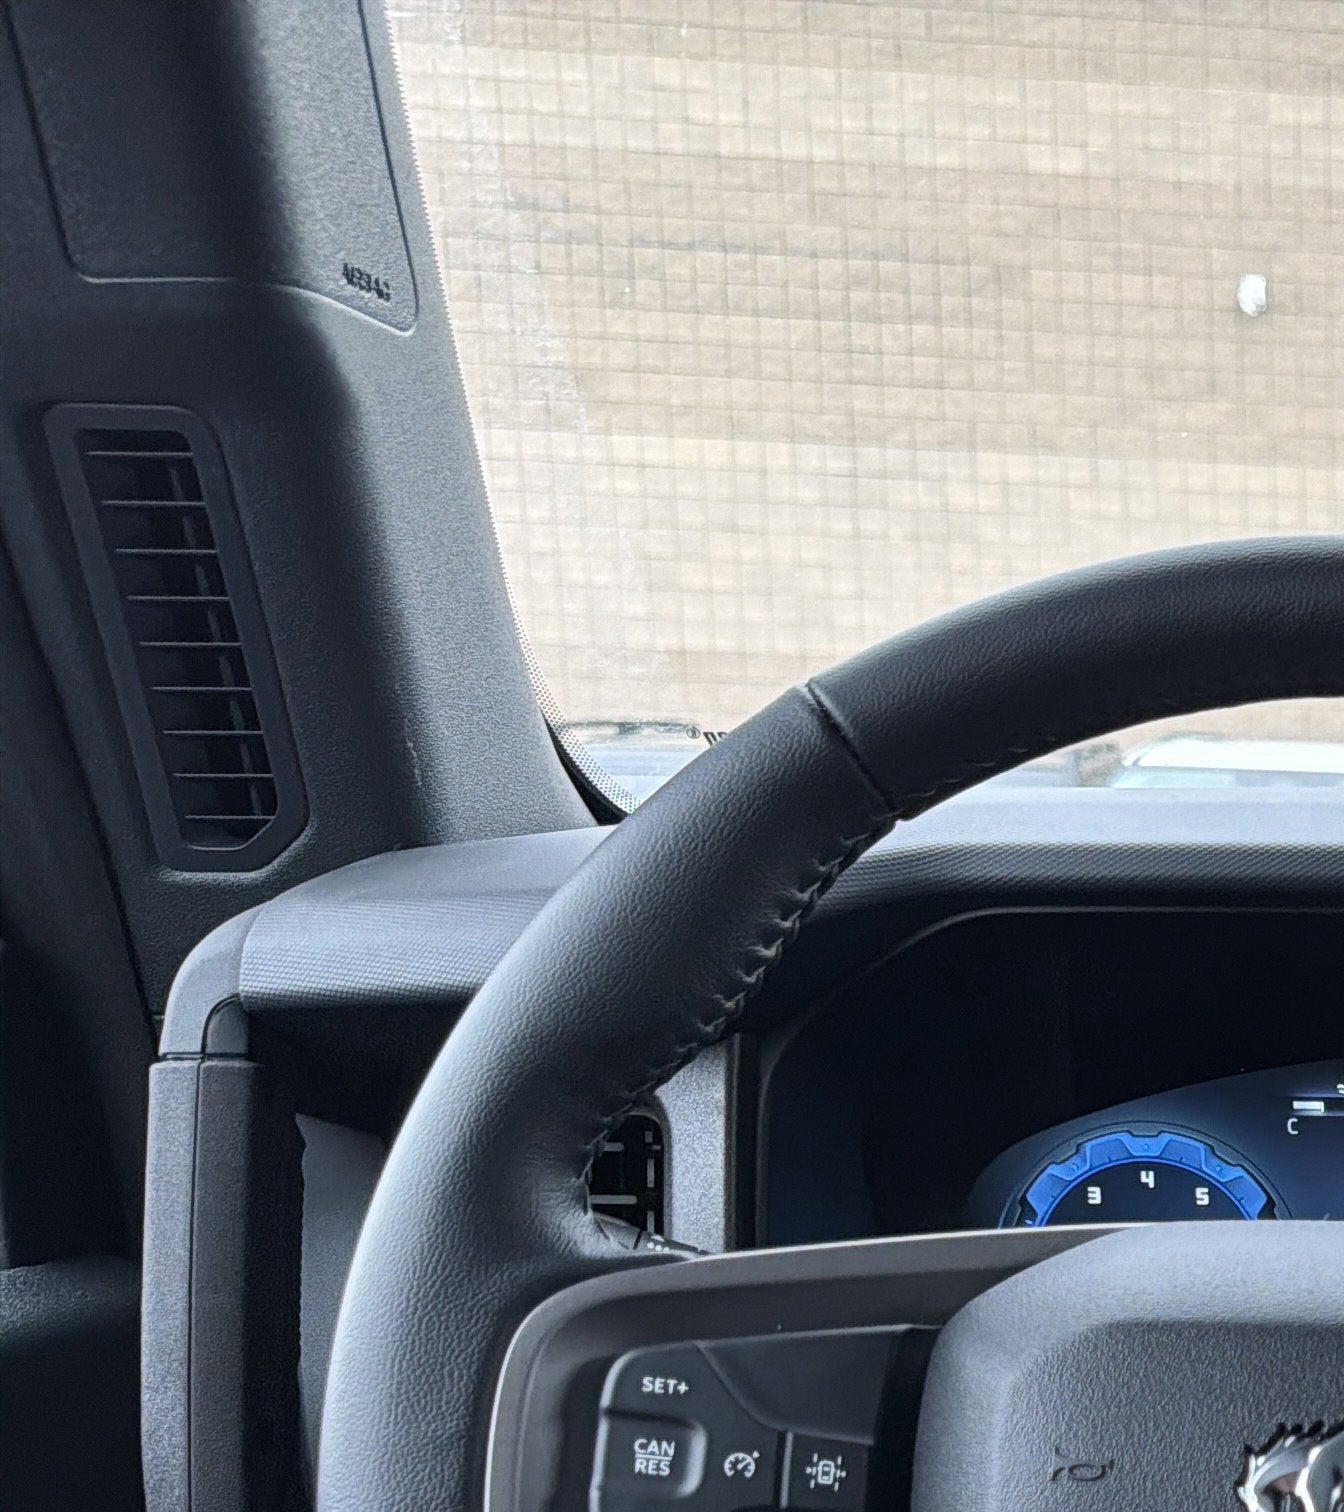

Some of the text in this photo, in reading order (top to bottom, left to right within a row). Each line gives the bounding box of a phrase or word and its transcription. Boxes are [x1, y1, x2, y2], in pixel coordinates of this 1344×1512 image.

[1287, 1118, 1299, 1135] C
[1140, 1171, 1155, 1188] 4
[1088, 1187, 1101, 1204] 3
[1195, 1188, 1209, 1205] 5
[641, 1376, 689, 1395] SET+
[634, 1439, 675, 1456] CAN
[634, 1459, 671, 1476] RES
